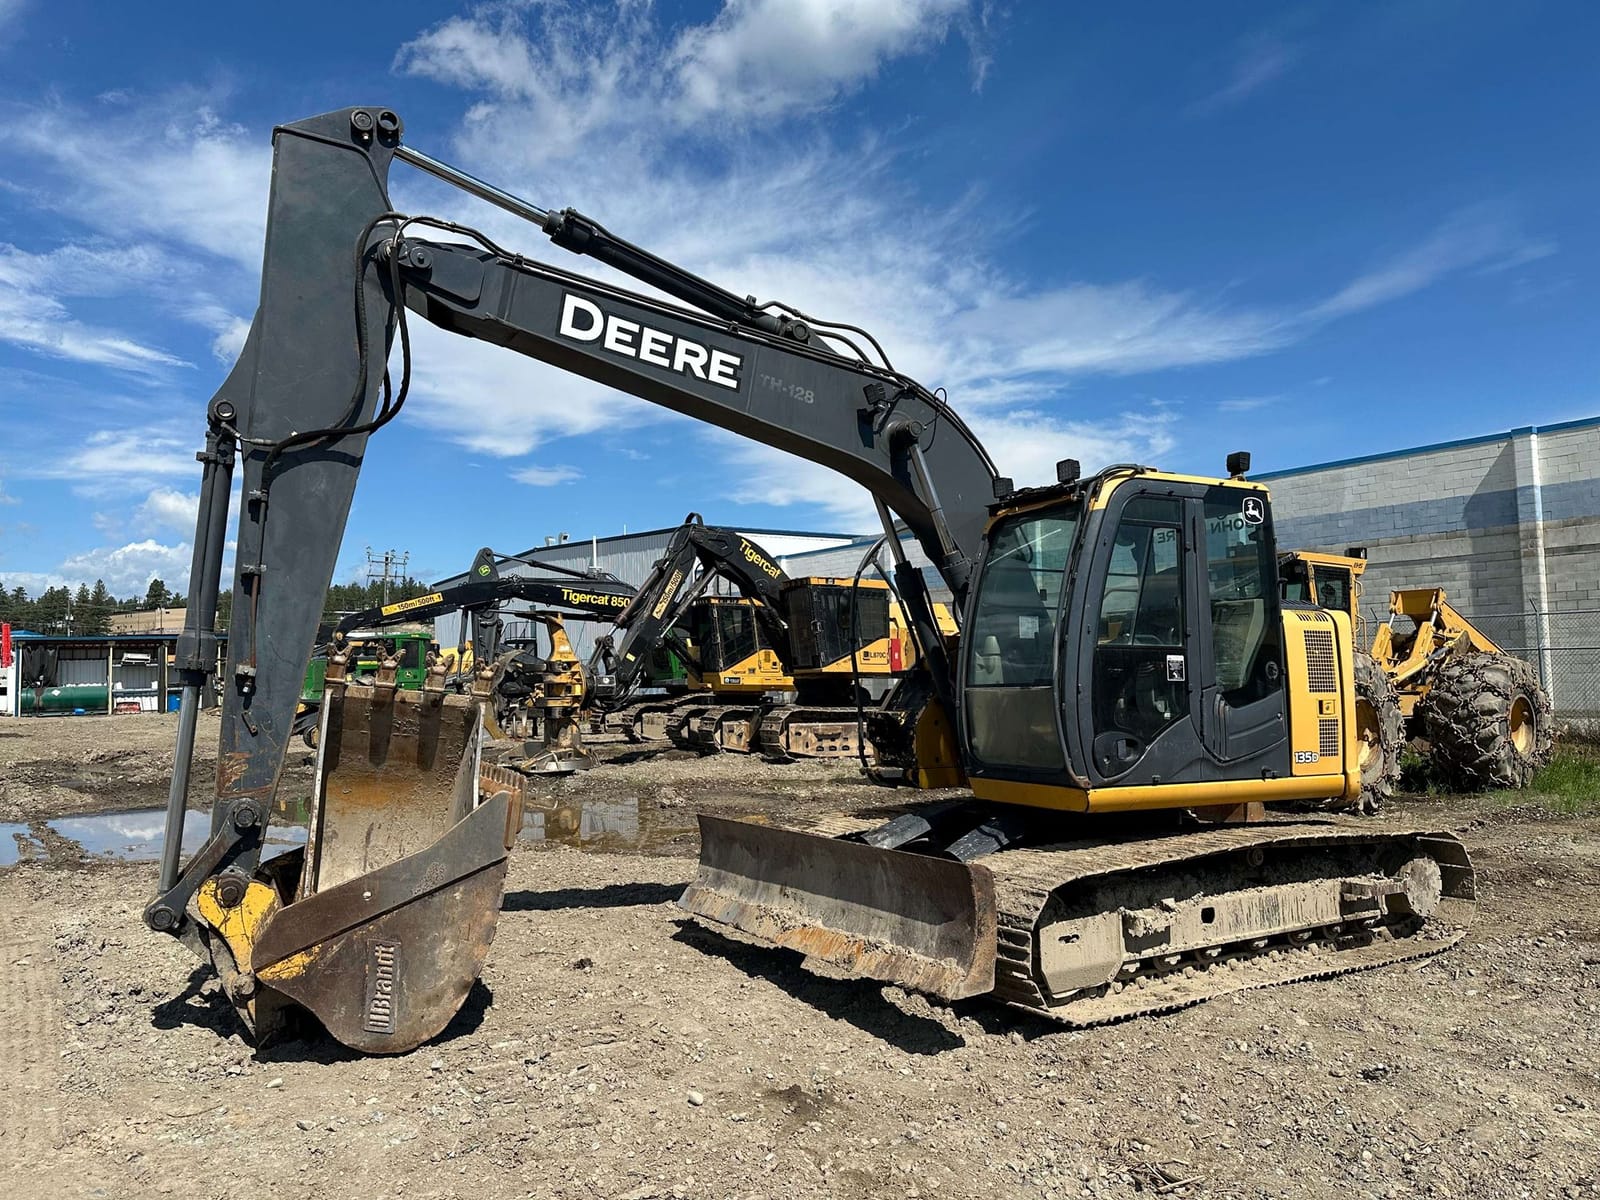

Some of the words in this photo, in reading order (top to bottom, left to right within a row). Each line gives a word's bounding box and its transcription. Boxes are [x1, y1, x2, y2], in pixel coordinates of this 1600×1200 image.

[559, 293, 741, 389] DEERE
[740, 538, 781, 579] Tigercat
[561, 589, 609, 605] Tigercat
[611, 596, 631, 607] 850
[1294, 751, 1319, 763] 135D
